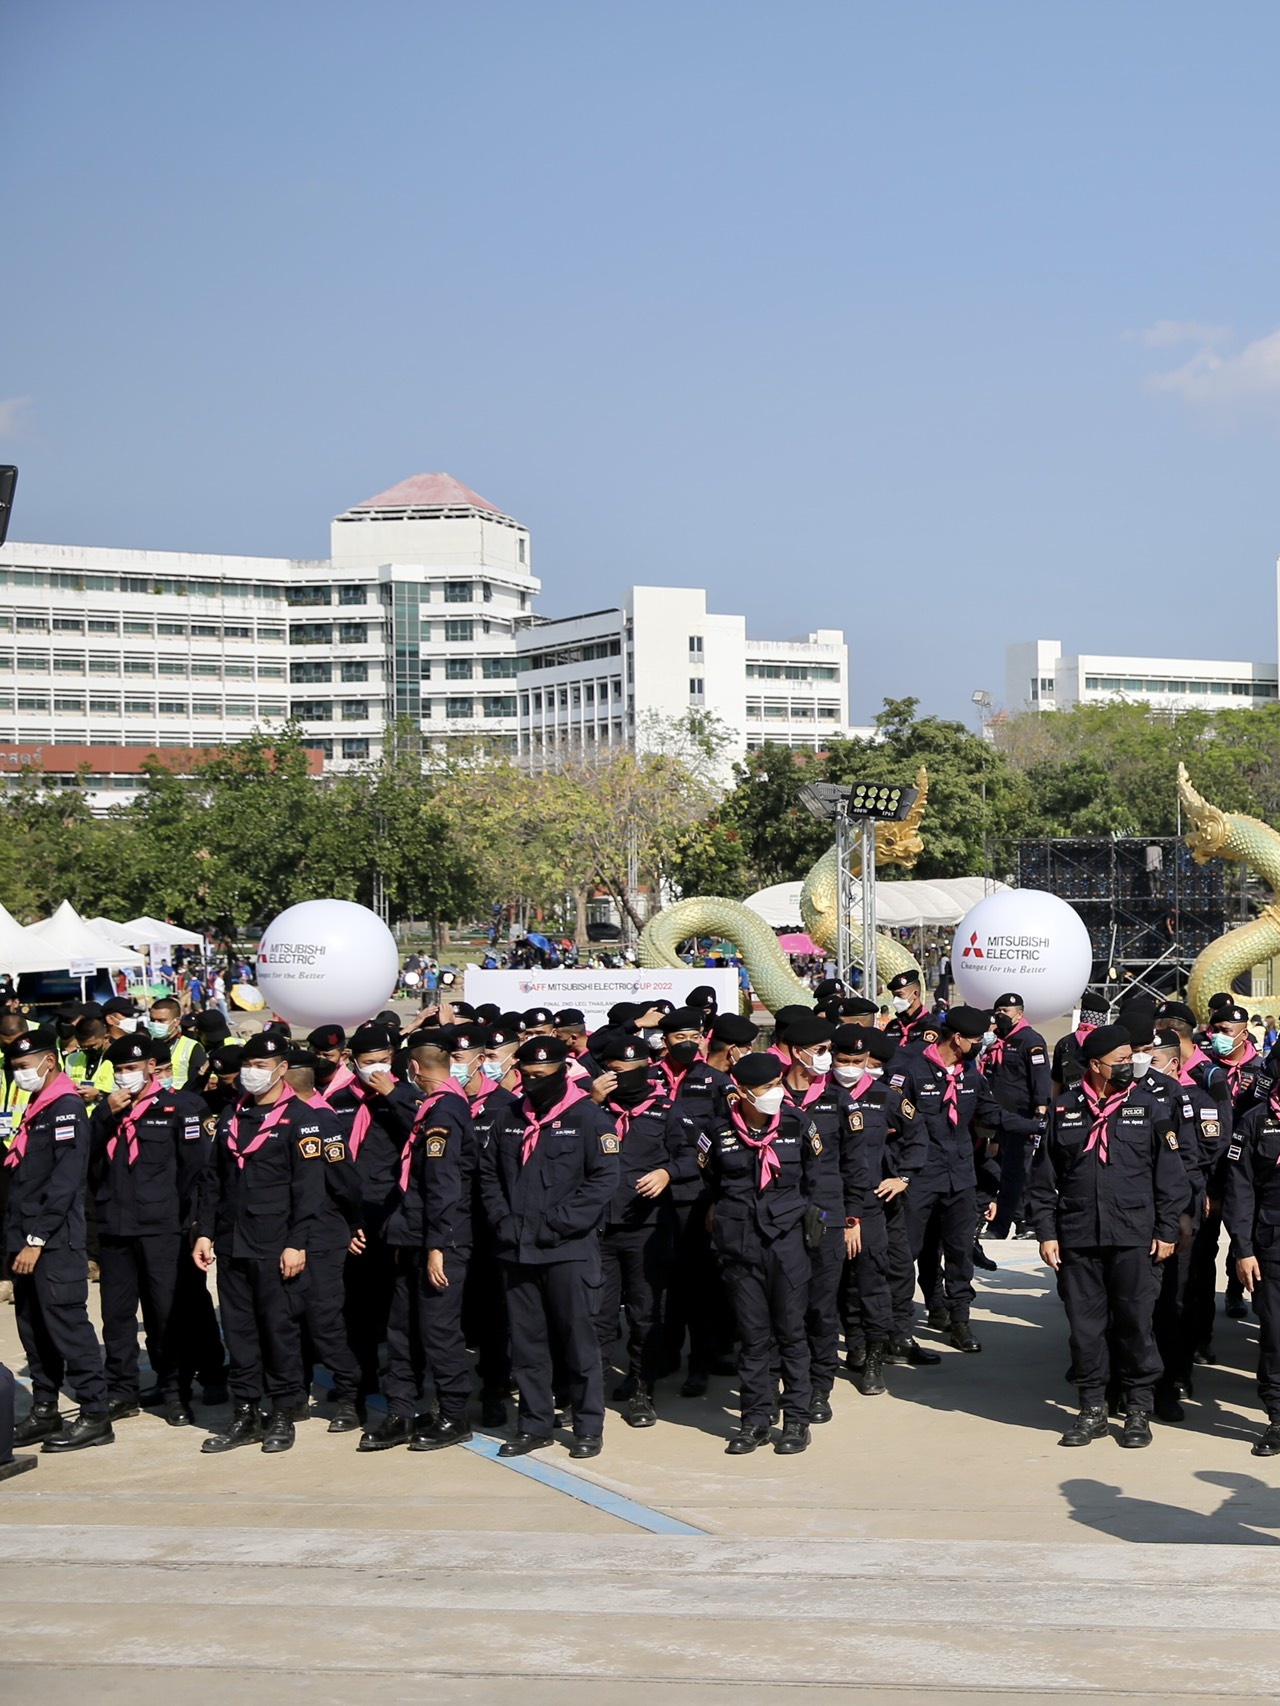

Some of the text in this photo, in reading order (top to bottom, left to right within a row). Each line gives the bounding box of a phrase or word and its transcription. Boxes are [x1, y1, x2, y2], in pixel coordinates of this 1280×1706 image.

[987, 936, 1050, 948] MITSUBISHI
[270, 943, 326, 955] MITSUBISHI
[986, 948, 1040, 960] ELECTRIC
[269, 954, 316, 965] ELECTRIC
[961, 961, 1047, 974] Changes for the Better
[298, 971, 326, 979] Better
[531, 982, 673, 991] AFF MITSUBISHI ELECTRIC CUP 2022
[56, 1113, 76, 1122] POLICE
[1122, 1108, 1145, 1117] POLICE
[300, 1125, 320, 1135] POLICE
